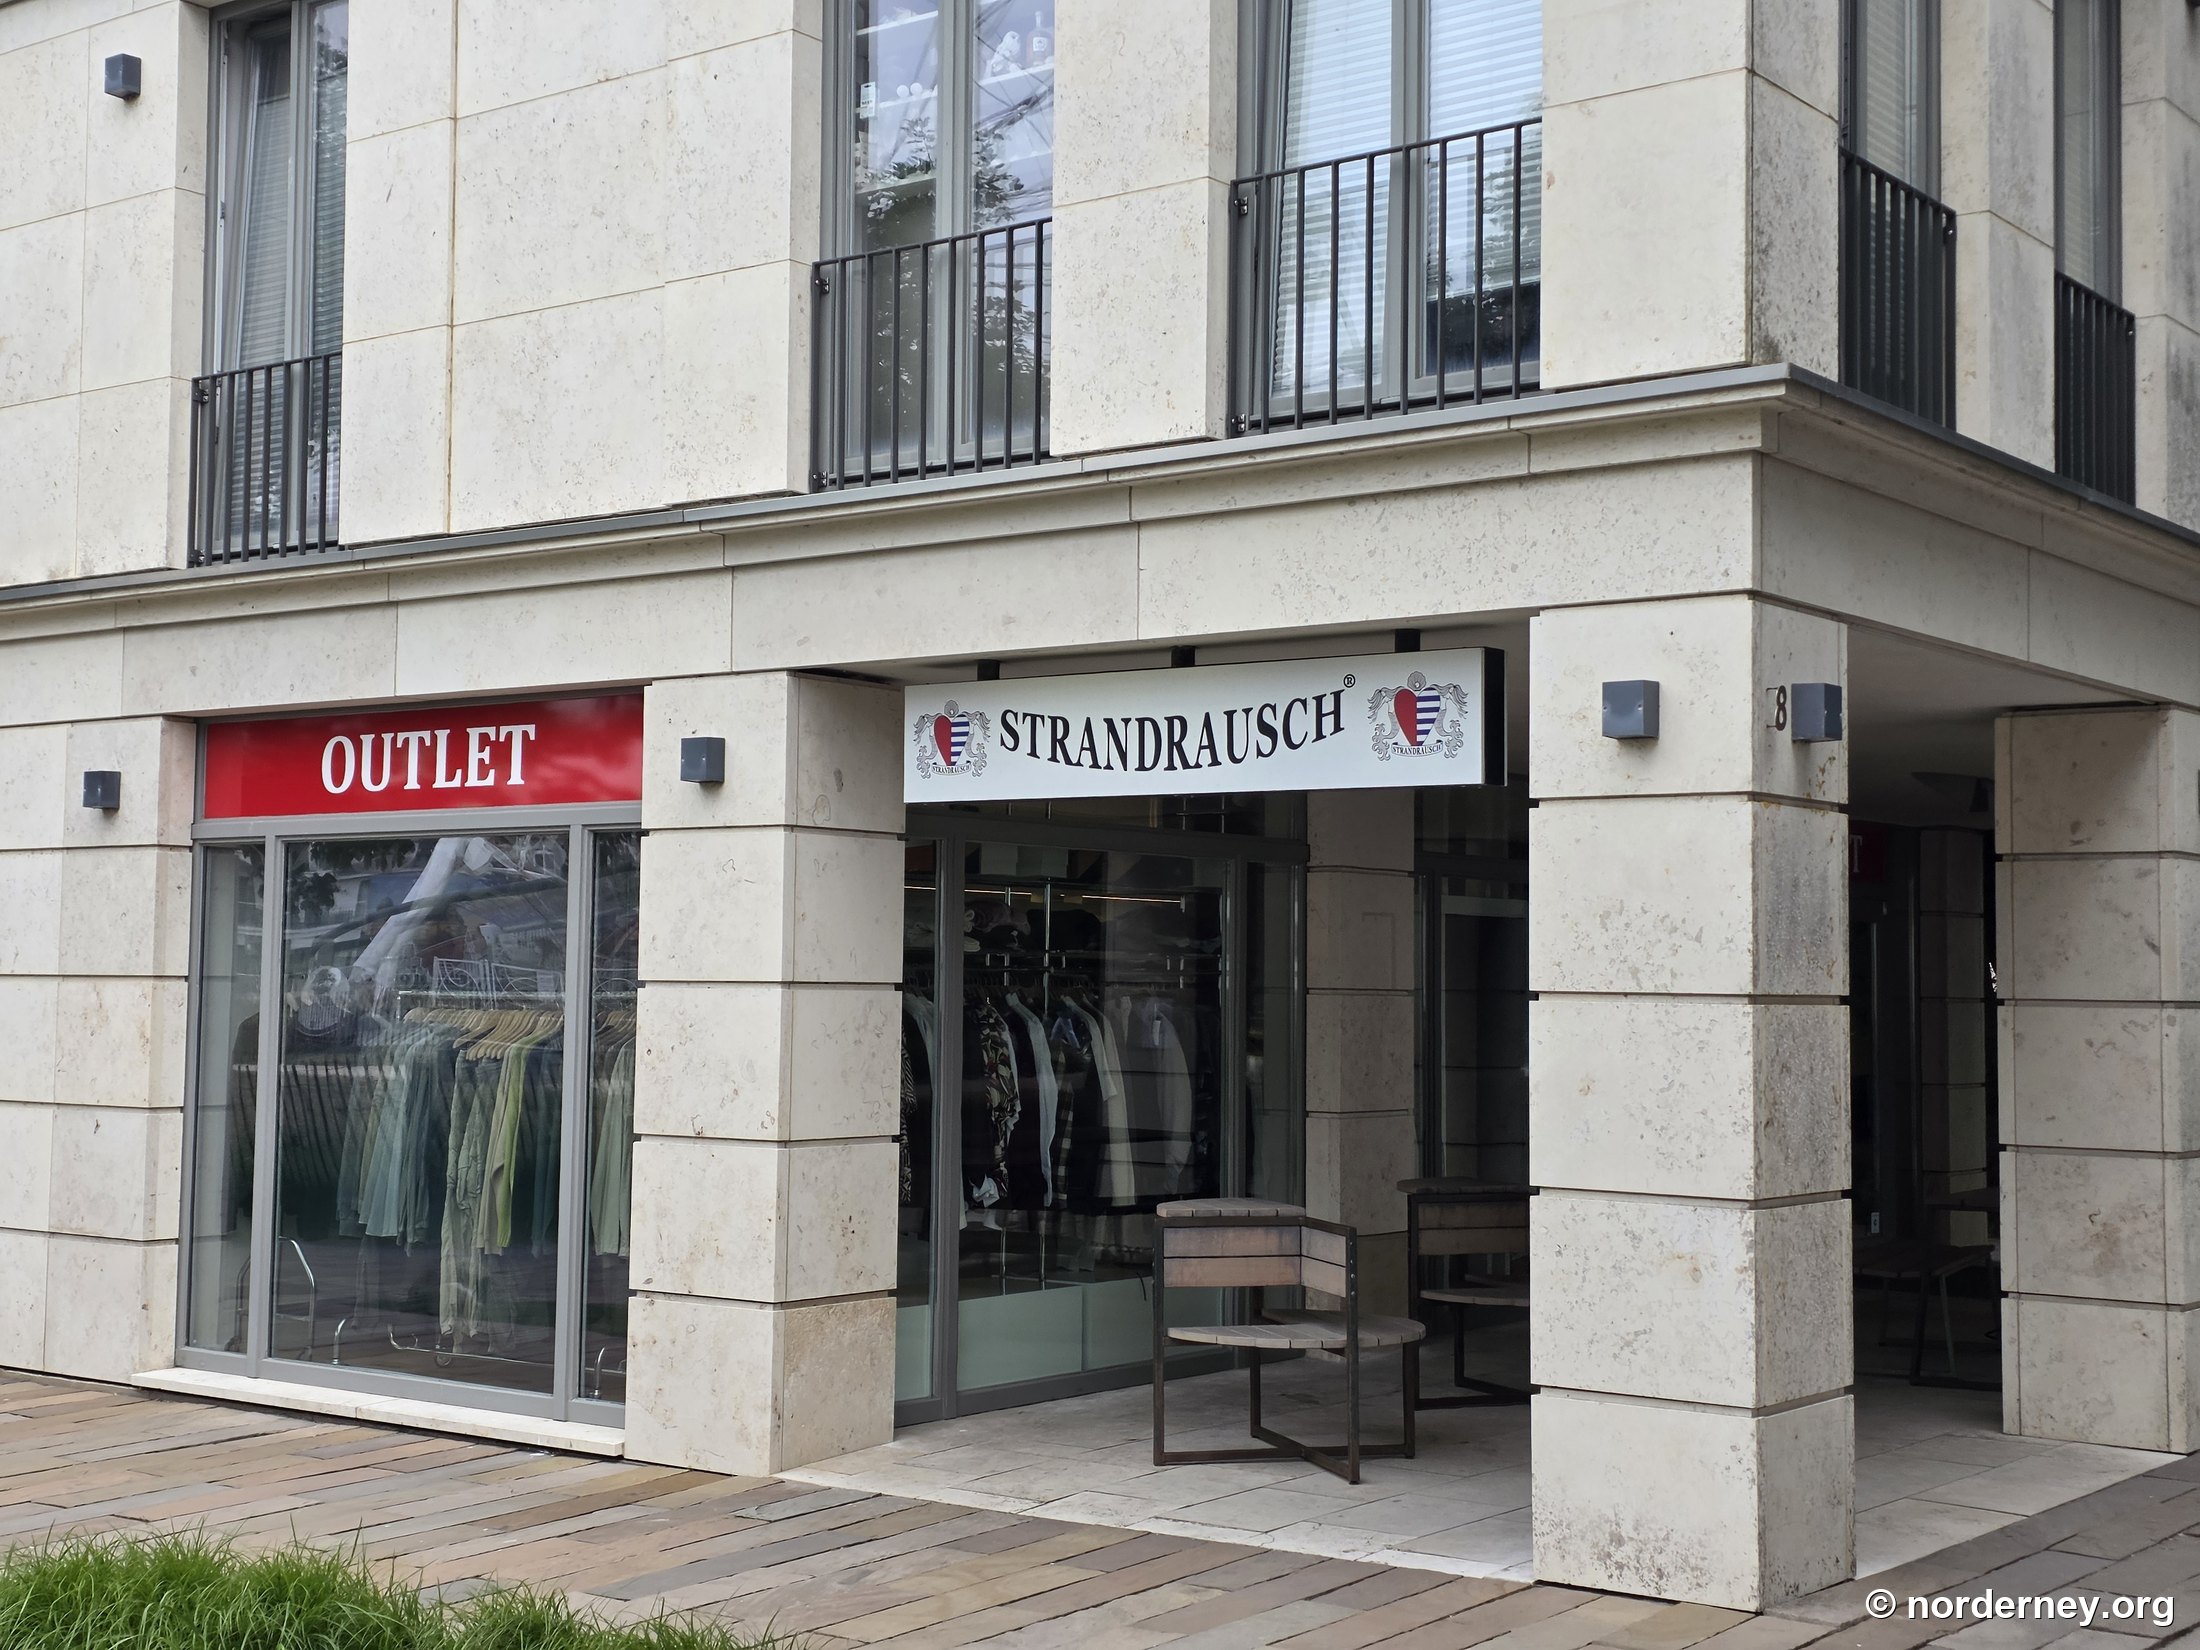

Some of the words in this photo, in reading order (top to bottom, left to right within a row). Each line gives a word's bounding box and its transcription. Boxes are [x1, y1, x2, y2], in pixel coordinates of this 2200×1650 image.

[1775, 685, 1787, 731] 8
[321, 724, 536, 794] OUTLET
[1392, 743, 1441, 755] STRANDRAUSCH
